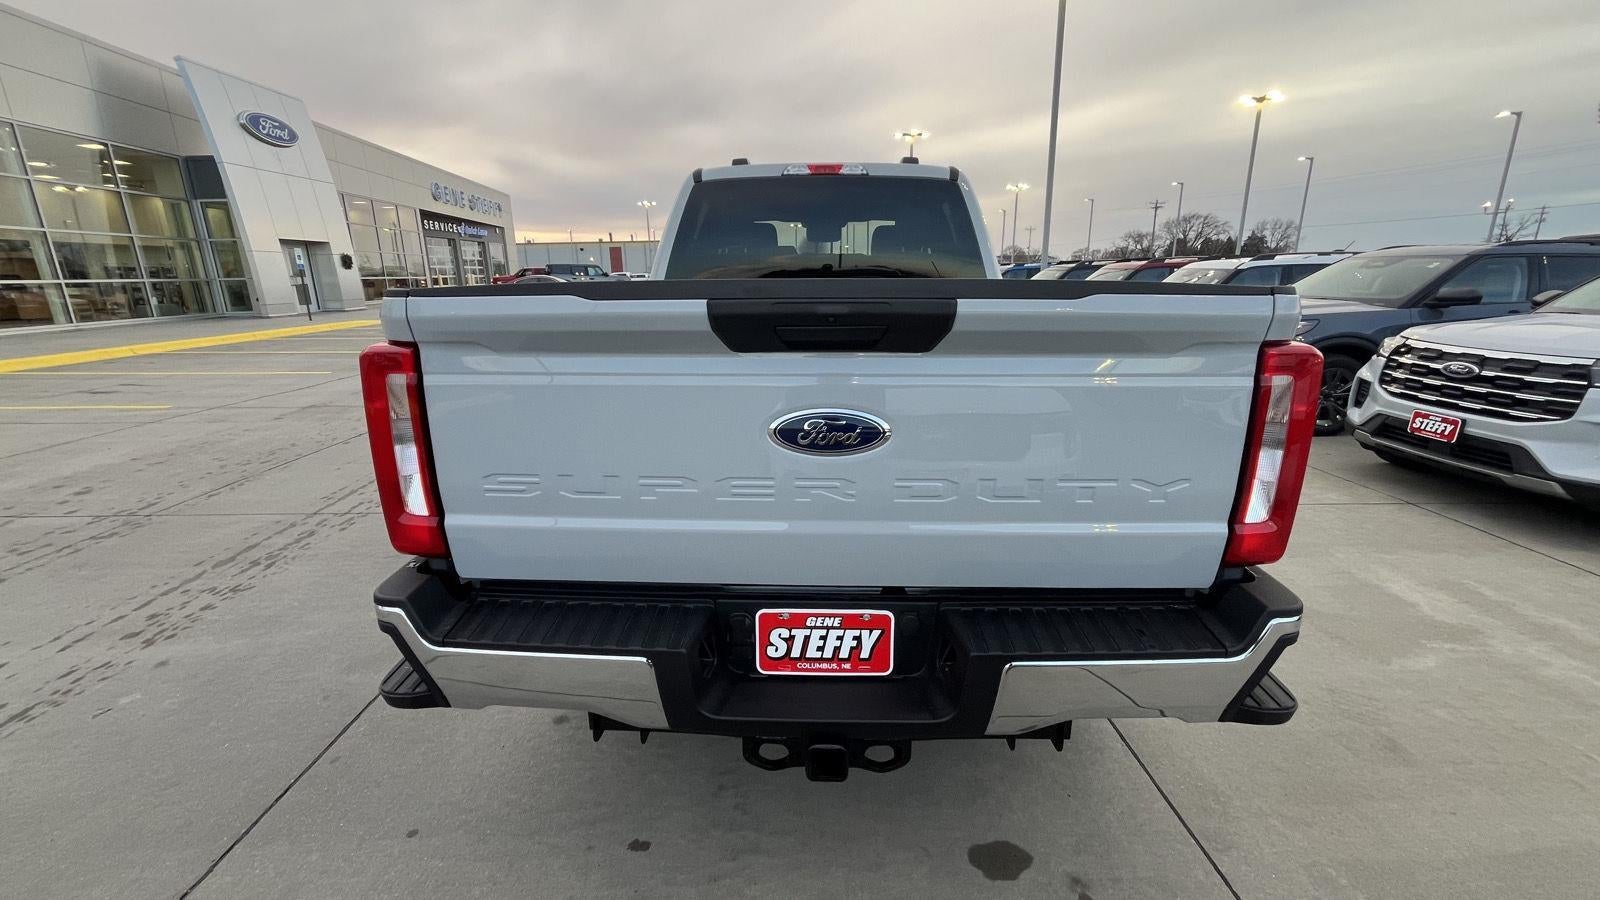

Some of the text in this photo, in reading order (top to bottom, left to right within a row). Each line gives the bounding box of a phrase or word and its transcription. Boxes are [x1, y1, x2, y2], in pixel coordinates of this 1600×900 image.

[259, 117, 290, 140] Ford
[431, 182, 465, 208] GENE
[423, 219, 457, 233] SERVICE
[797, 419, 862, 445] Ford
[1412, 417, 1455, 435] STEFFY
[482, 473, 1191, 503] SUPER DUTY
[806, 617, 842, 626] GENE
[766, 628, 882, 658] STEFFY
[797, 662, 852, 670] COLUMBUS, NE
